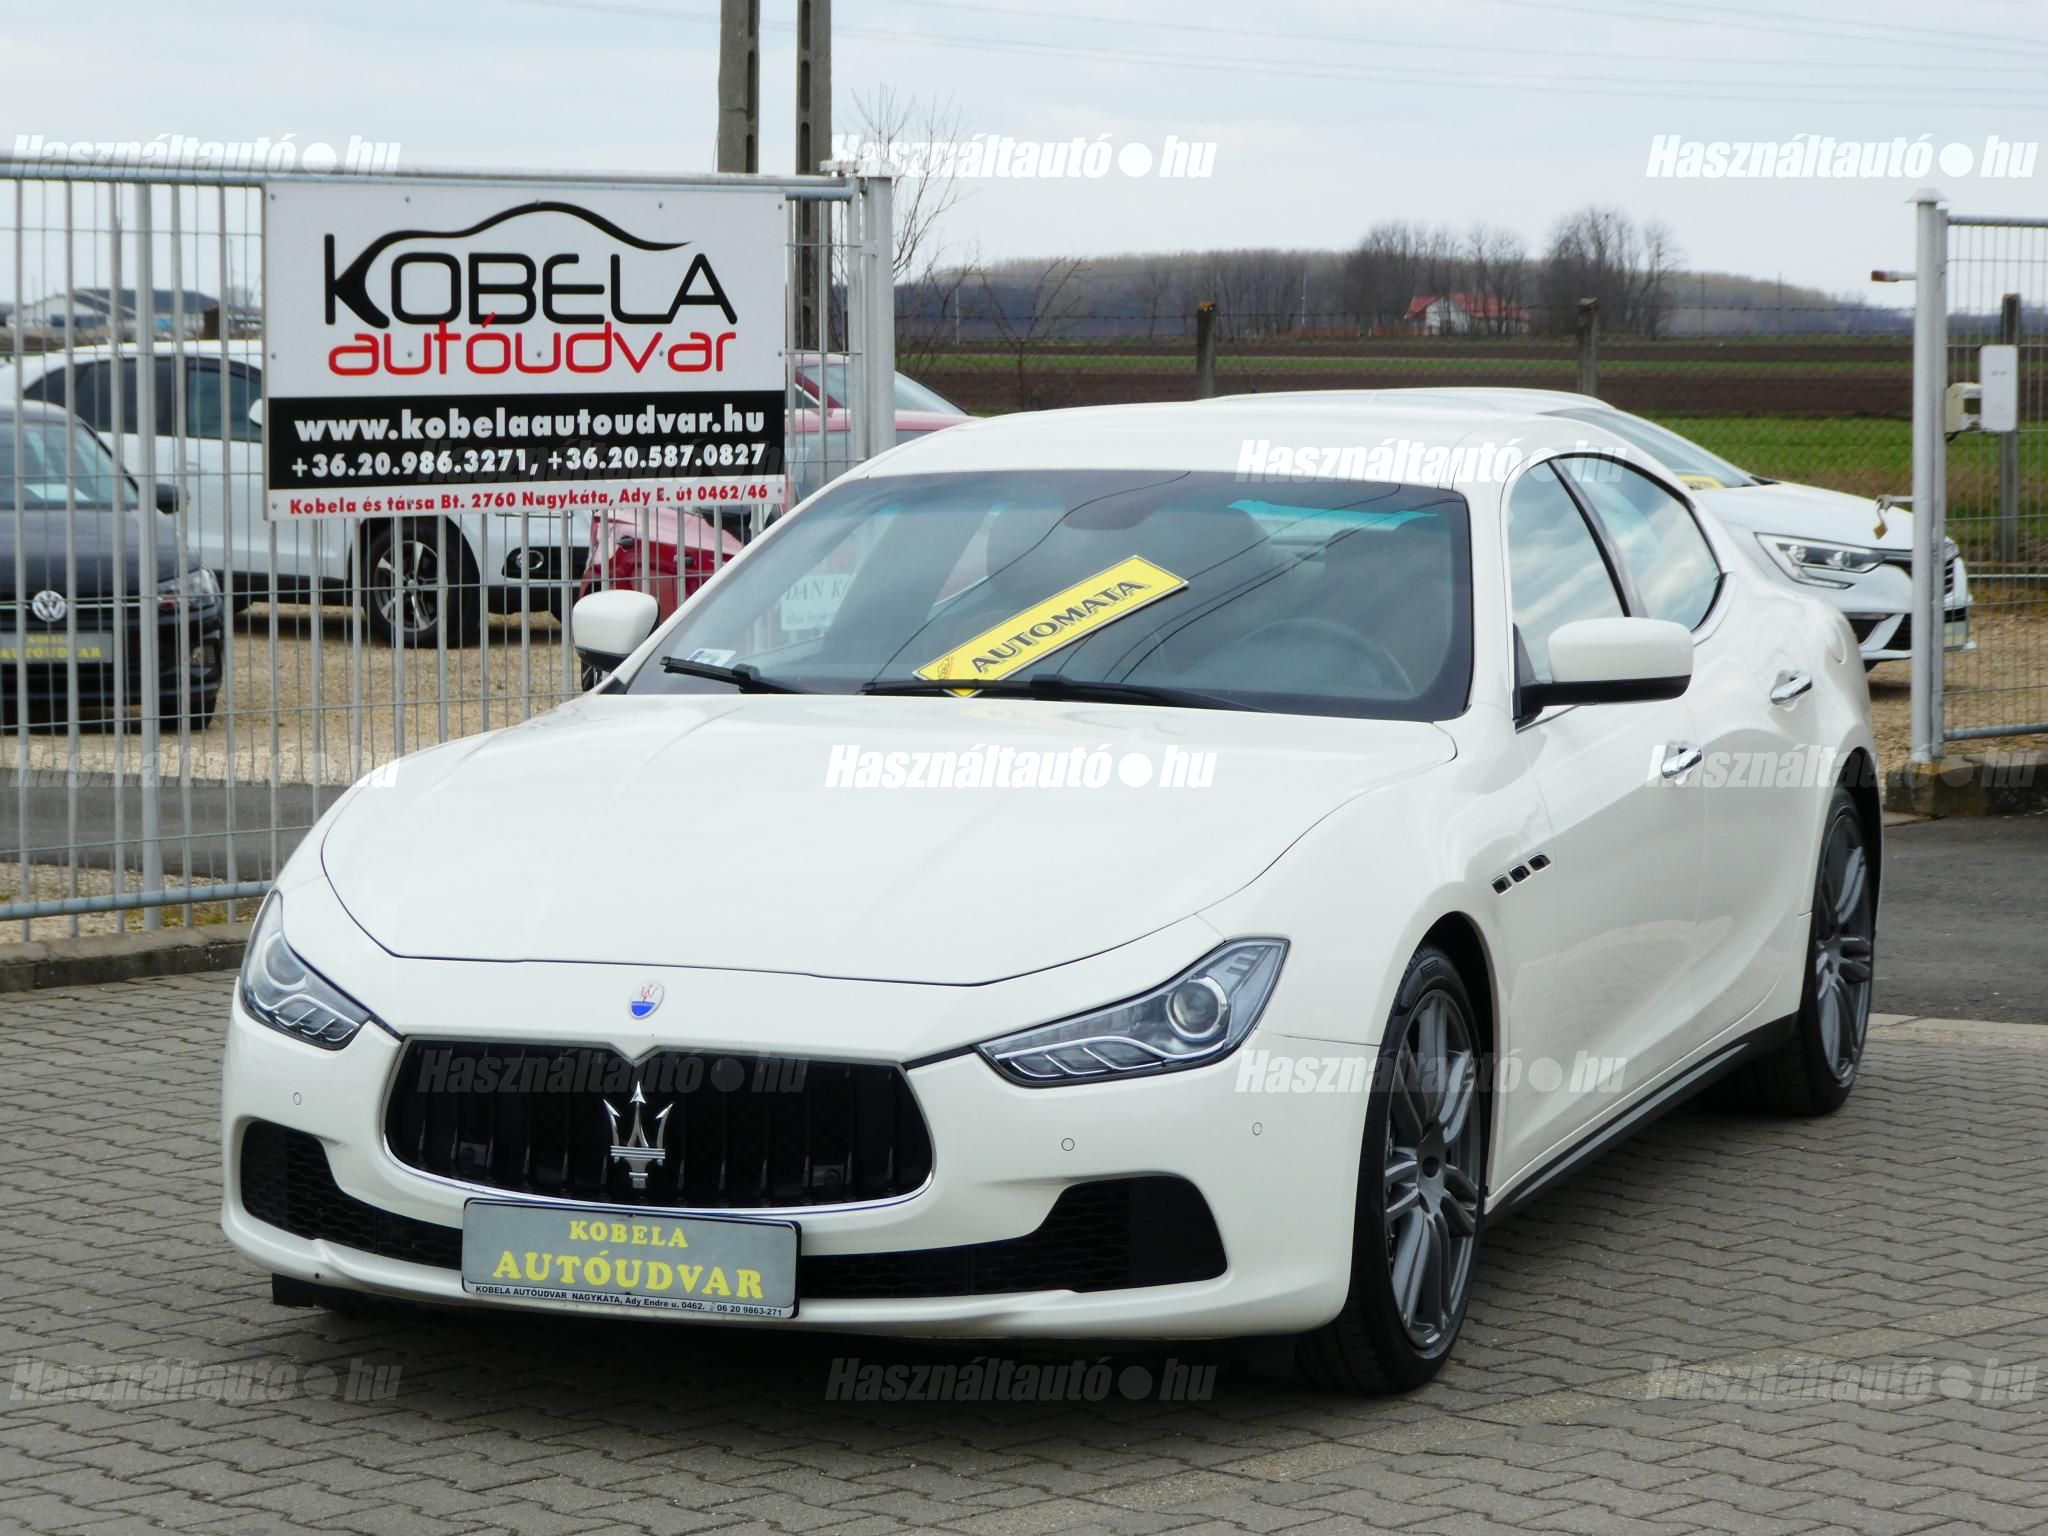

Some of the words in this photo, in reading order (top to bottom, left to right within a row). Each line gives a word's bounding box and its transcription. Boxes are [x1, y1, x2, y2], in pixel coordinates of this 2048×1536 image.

[324, 233, 738, 329] KOBELA
[328, 311, 737, 376] autóudvar
[295, 403, 765, 442] www.kobelaautoudvar.hu
[291, 448, 540, 477] +36.20.986.3271,
[547, 442, 766, 471] +36.20.587.0827
[289, 497, 357, 515] Kobela
[362, 496, 382, 512] és
[387, 495, 435, 511] társa
[441, 494, 466, 509] Bt.
[471, 492, 517, 508] 2760
[522, 488, 615, 510] Nagykáta,
[619, 487, 652, 506] Ady
[656, 486, 671, 502] E.
[676, 485, 694, 501] út
[697, 483, 769, 501] 0462/46
[971, 580, 1151, 674] AUTOMATA
[569, 1220, 689, 1248] KOBELA
[492, 1250, 764, 1299] AUTÓUDVAR
[475, 1285, 511, 1295] KOBELA
[625, 1296, 642, 1307] Ady
[643, 1298, 669, 1308] Endre
[717, 1303, 728, 1312] 06
[730, 1304, 741, 1313] 20
[743, 1306, 783, 1317] 9863-271
